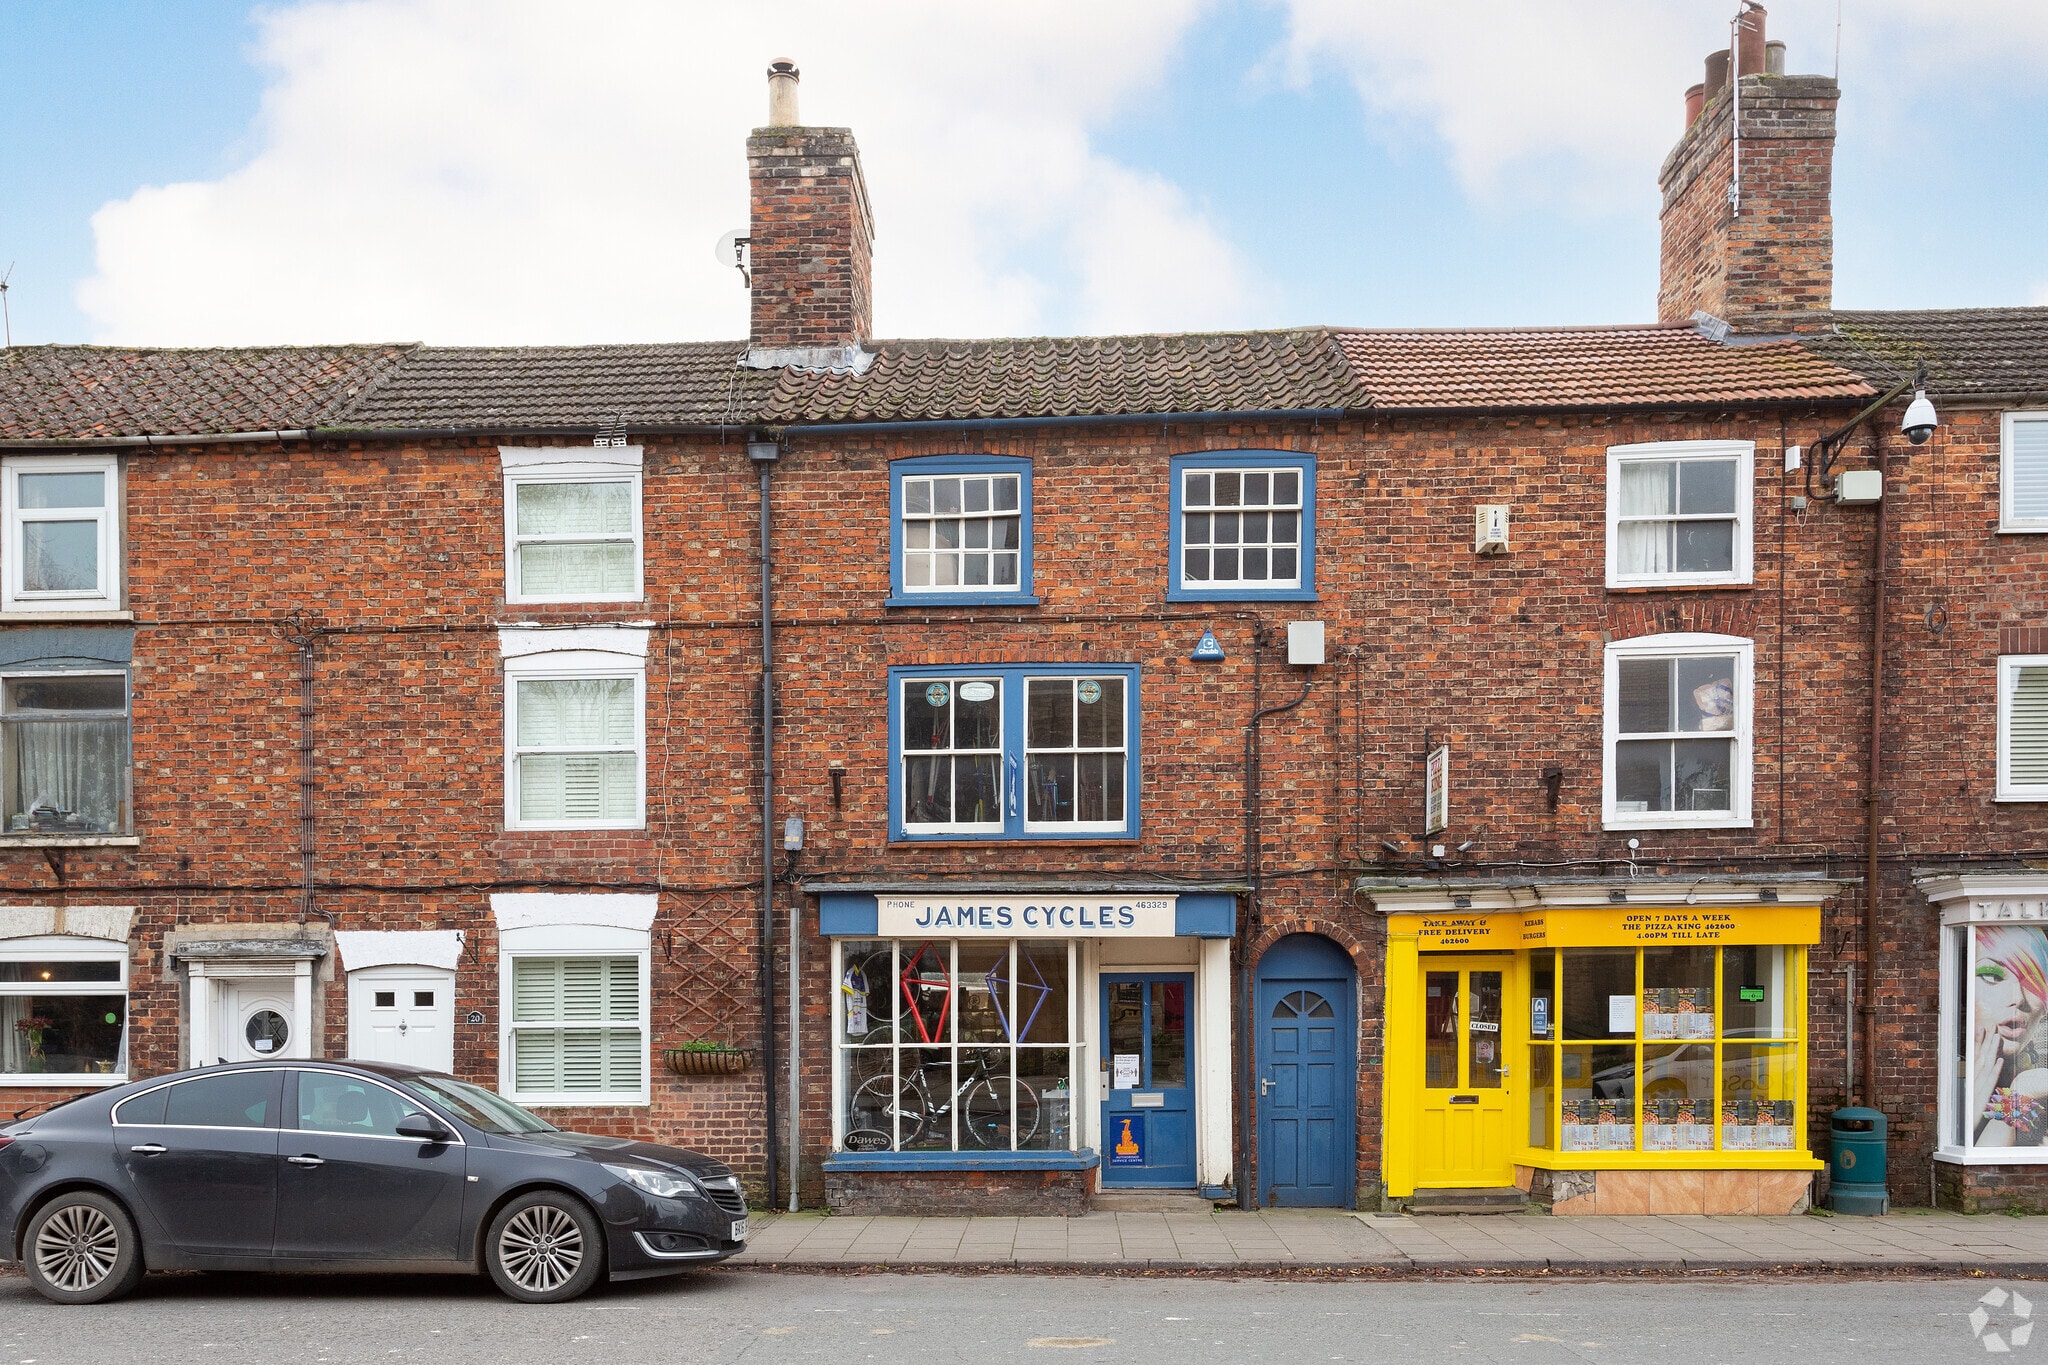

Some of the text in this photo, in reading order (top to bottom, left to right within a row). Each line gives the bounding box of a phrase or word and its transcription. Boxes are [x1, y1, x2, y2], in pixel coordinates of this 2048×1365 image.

[1135, 901, 1168, 909] 463329
[915, 905, 1137, 928] JAMES CYCLES
[1524, 919, 1544, 927] KEBABS
[1445, 928, 1491, 936] DELIVERY
[1522, 932, 1546, 940] BURGERS
[1471, 1023, 1497, 1031] CLOSED
[848, 1135, 888, 1145] Dawes
